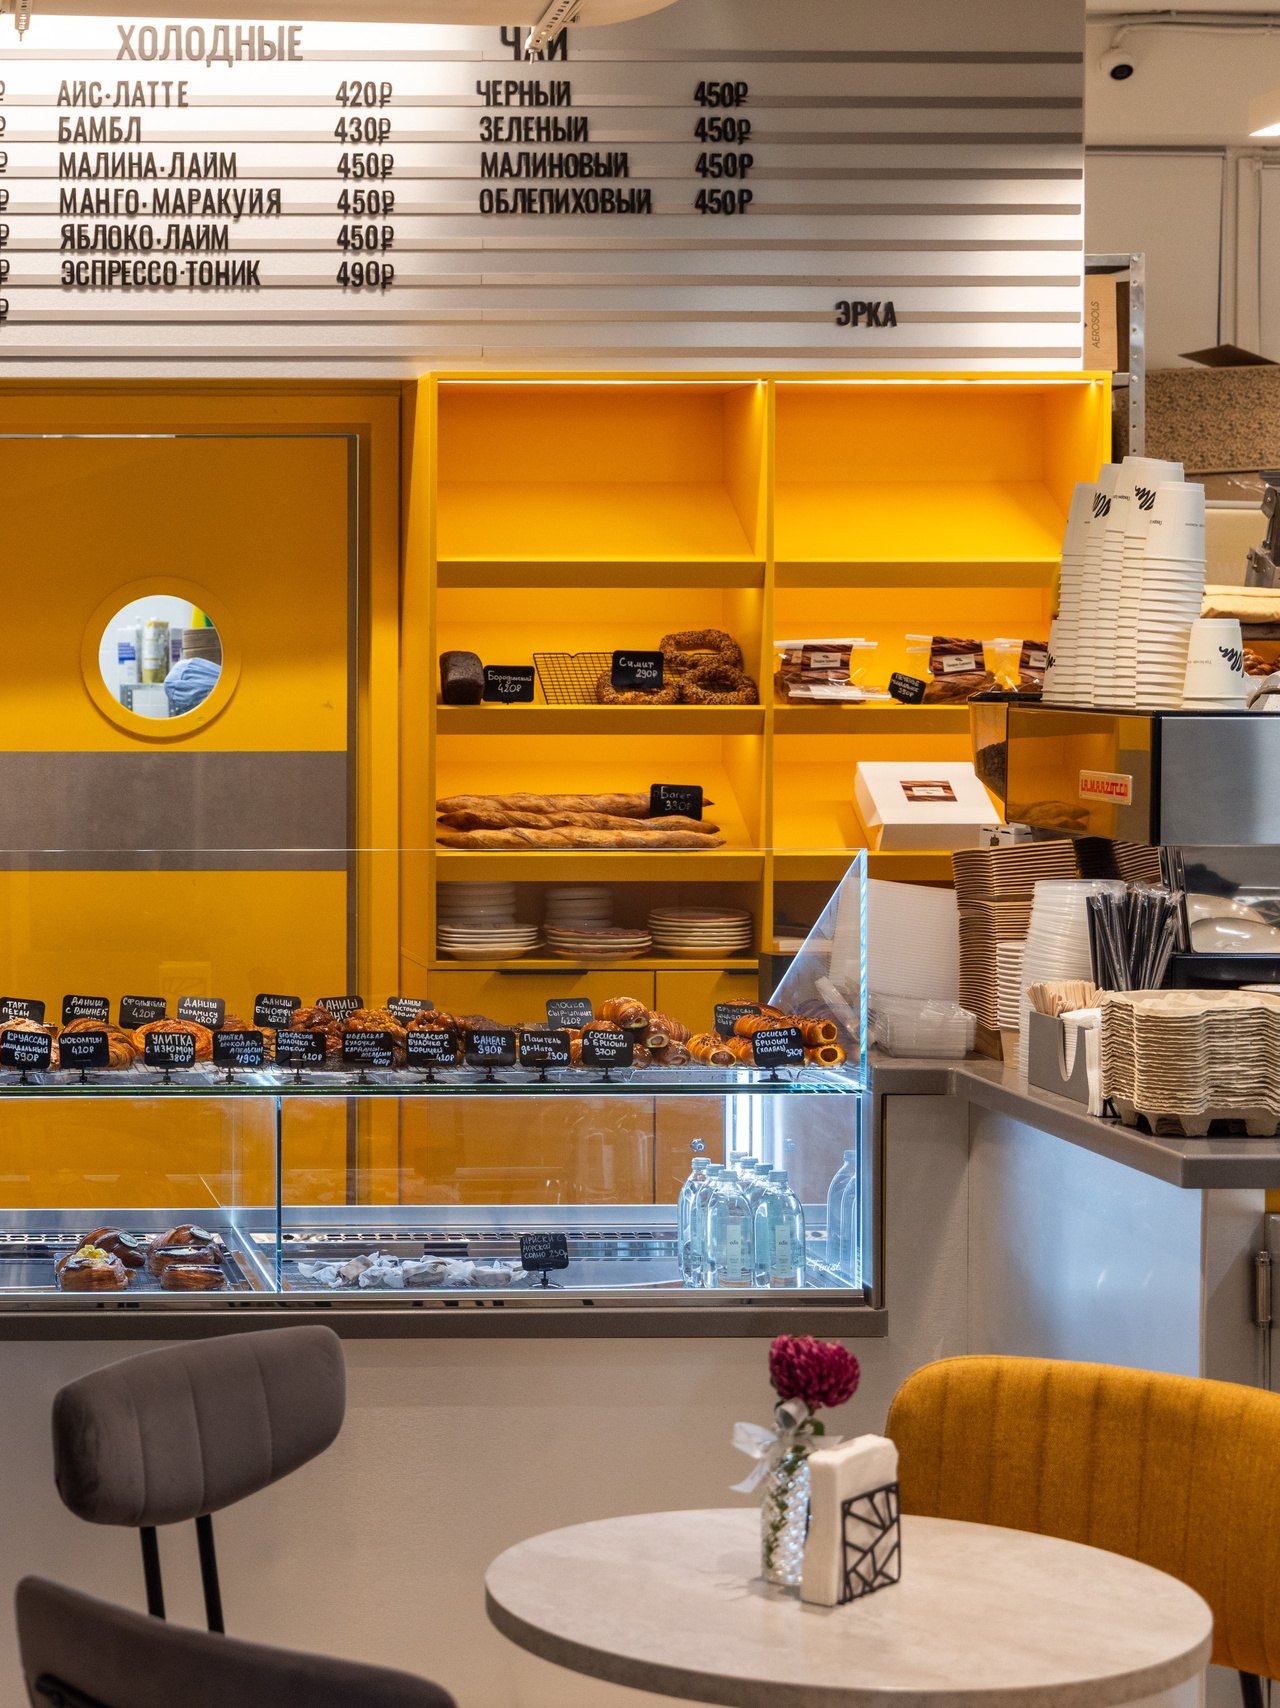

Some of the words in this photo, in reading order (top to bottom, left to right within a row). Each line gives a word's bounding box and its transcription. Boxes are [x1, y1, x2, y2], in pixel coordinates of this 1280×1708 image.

[116, 25, 303, 68] ХОЛОДНЫЕ
[477, 80, 571, 106] ЧЕРНЫЙ
[58, 116, 141, 143] БАМБЛ
[479, 116, 588, 142] ЗЕЛЕНЫЙ
[480, 152, 628, 178] МАЛИНОВЫЙ
[479, 188, 652, 214] ОБЛЕПИХОВЫЙ
[835, 300, 897, 327] ЭРКА
[1090, 301, 1100, 349] AEROSOLS
[152, 1034, 193, 1046] УЛИТКА
